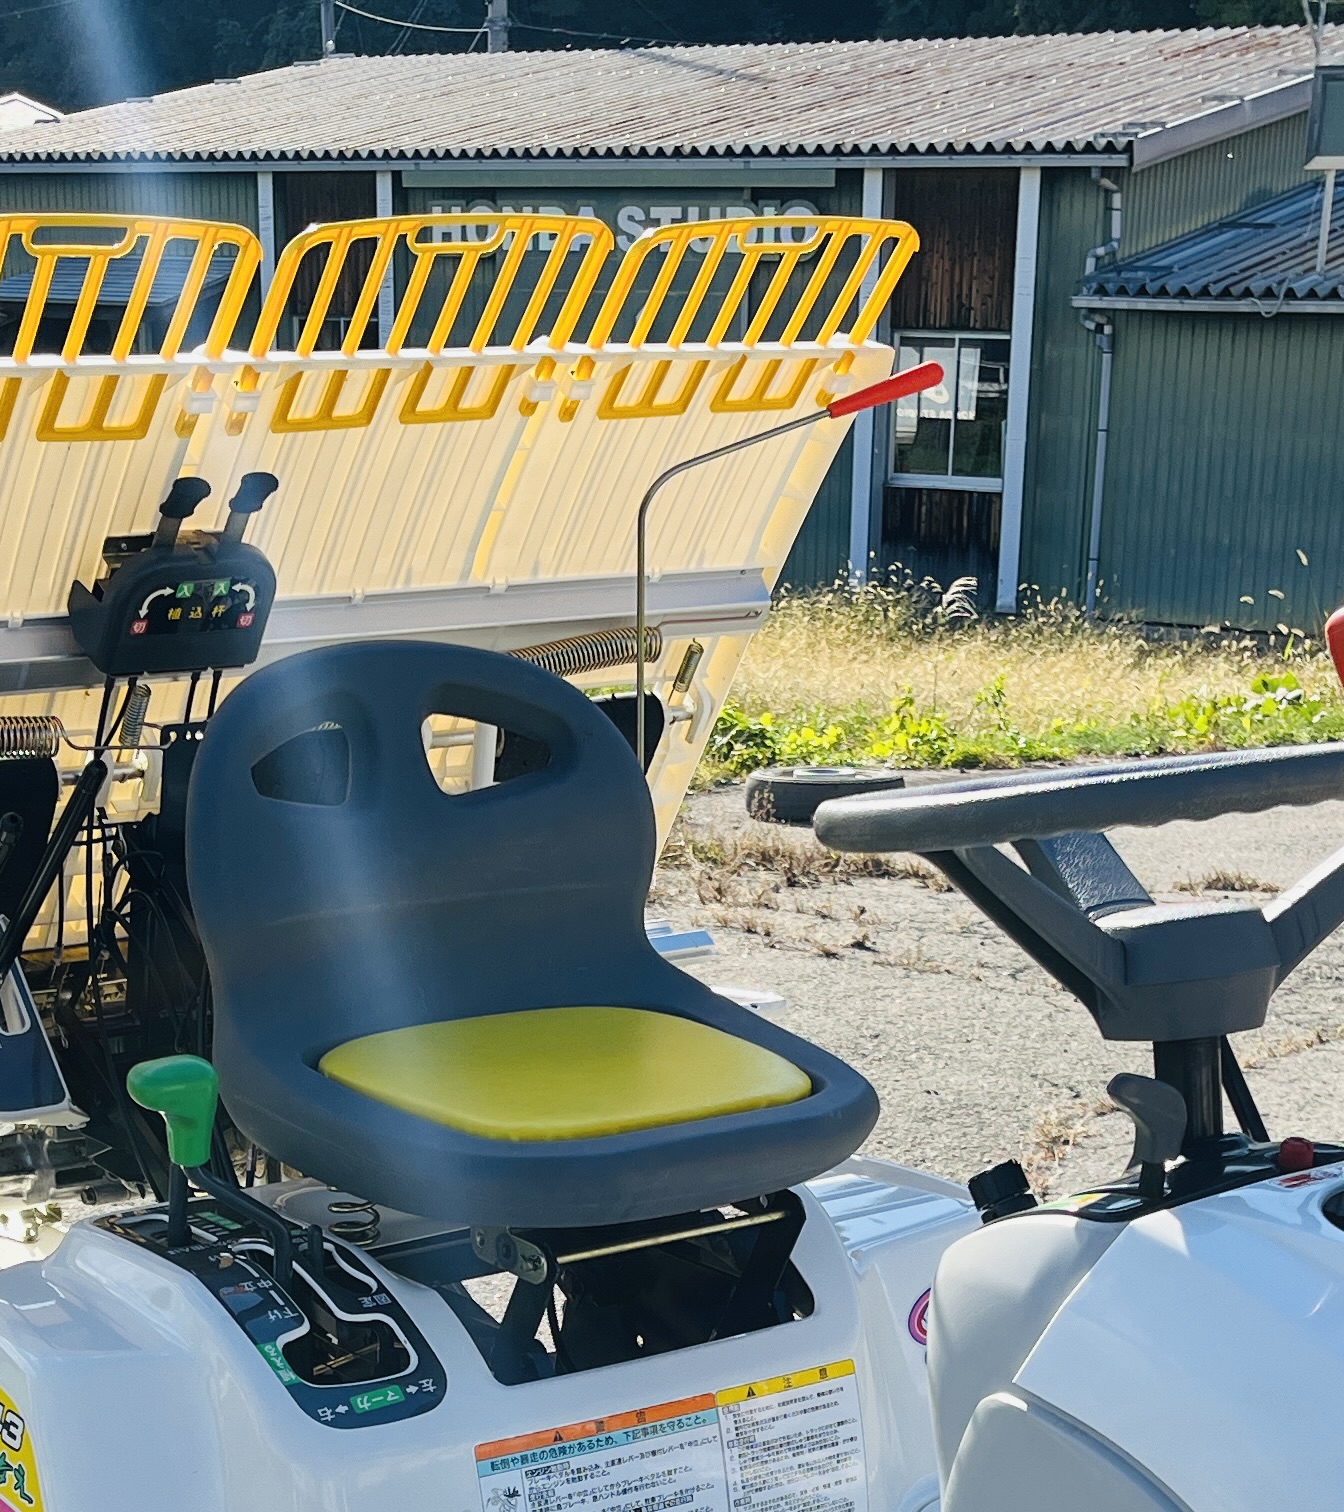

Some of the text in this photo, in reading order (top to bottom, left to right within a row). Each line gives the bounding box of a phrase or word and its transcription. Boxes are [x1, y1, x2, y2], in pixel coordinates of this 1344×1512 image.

[357, 1292, 393, 1308] 固定
[418, 1378, 438, 1393] 左
[357, 1389, 400, 1411] マーカ
[317, 1407, 336, 1422] 右
